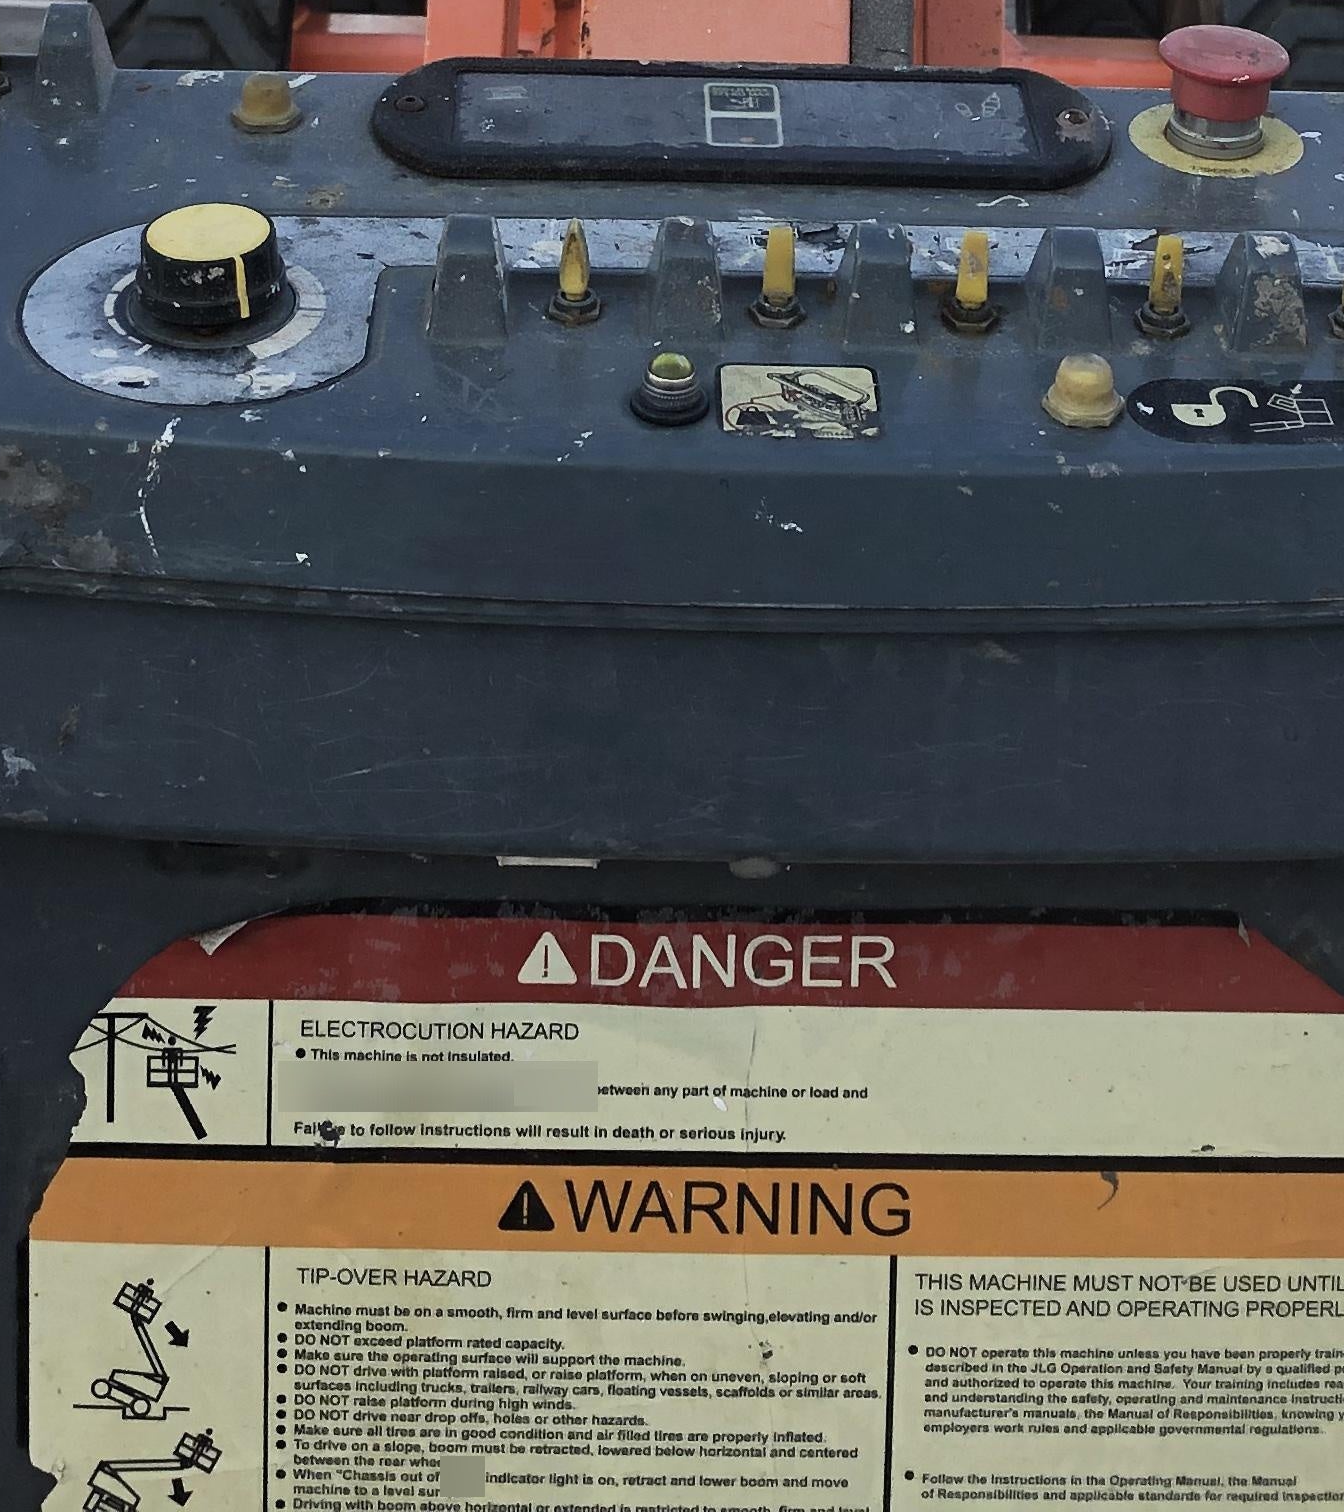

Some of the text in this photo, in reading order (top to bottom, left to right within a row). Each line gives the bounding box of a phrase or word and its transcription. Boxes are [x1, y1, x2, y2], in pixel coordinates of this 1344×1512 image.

[590, 933, 897, 989] DANGER
[300, 1019, 579, 1041] ELECTROCUTION HAZARD
[310, 1047, 514, 1061] This machine is not insulated.
[653, 1086, 678, 1099] any
[682, 1084, 709, 1100] part
[712, 1084, 726, 1097] of
[730, 1084, 787, 1099] machine
[791, 1088, 806, 1098] or
[809, 1085, 838, 1099] load
[842, 1086, 868, 1099] and
[350, 1123, 365, 1137] to
[369, 1123, 416, 1137] follow
[420, 1124, 510, 1138] instructions
[515, 1125, 541, 1138] will
[546, 1125, 589, 1139] result
[594, 1126, 607, 1139] in
[612, 1126, 654, 1140] death
[658, 1128, 675, 1139] or
[679, 1126, 736, 1140] serious
[740, 1127, 786, 1144] injury.
[564, 1179, 912, 1238] WARNING
[297, 1266, 491, 1288] TIP-OVER HAZARD
[914, 1273, 962, 1291] THIS
[969, 1273, 1066, 1292] MACHINE
[1073, 1274, 1134, 1292] MUST
[1138, 1275, 1184, 1292] NOT
[1189, 1275, 1216, 1292] BE
[1222, 1274, 1281, 1292] USED
[294, 1303, 352, 1317] Machine
[355, 1305, 390, 1318] must
[393, 1304, 410, 1317] be
[413, 1307, 431, 1318] on
[435, 1307, 443, 1318] a
[446, 1305, 502, 1321] smooth,
[506, 1306, 533, 1319] firm
[537, 1307, 562, 1320] and
[566, 1307, 598, 1320] level
[601, 1307, 652, 1321] surface
[655, 1308, 699, 1322] before
[833, 1310, 877, 1323] and/or
[914, 1298, 933, 1316] IS
[940, 1298, 1061, 1318] INSPECTED
[1064, 1299, 1110, 1317] AND
[1116, 1299, 1239, 1318] OPERATING
[294, 1319, 408, 1336] extending boom.
[294, 1333, 564, 1353] DO NOT exceed platform rated capacity.
[294, 1348, 685, 1368] Make sure the operating surface will support the machine.
[925, 1346, 946, 1358] DO
[949, 1345, 977, 1359] NOT
[980, 1347, 1029, 1360] operate
[1032, 1347, 1056, 1358] this
[1059, 1347, 1114, 1359] machine
[1117, 1348, 1159, 1360] unless
[1163, 1350, 1186, 1362] you
[1190, 1348, 1220, 1360] have
[1224, 1347, 1254, 1360] been
[1258, 1347, 1311, 1362] properly
[924, 1361, 988, 1375] described
[991, 1363, 1003, 1373] in
[1006, 1362, 1027, 1374] the
[1030, 1362, 1056, 1374] JLG
[1060, 1362, 1123, 1376] Operation
[1124, 1362, 1150, 1375] and
[1154, 1362, 1194, 1377] Safety
[1197, 1363, 1242, 1375] Manual
[1246, 1363, 1262, 1378] by
[1275, 1362, 1330, 1376] qualified
[293, 1393, 576, 1413] DO NOT raise platform during high winds.
[923, 1422, 1326, 1438] employers work rules and applicable governmental regulations.
